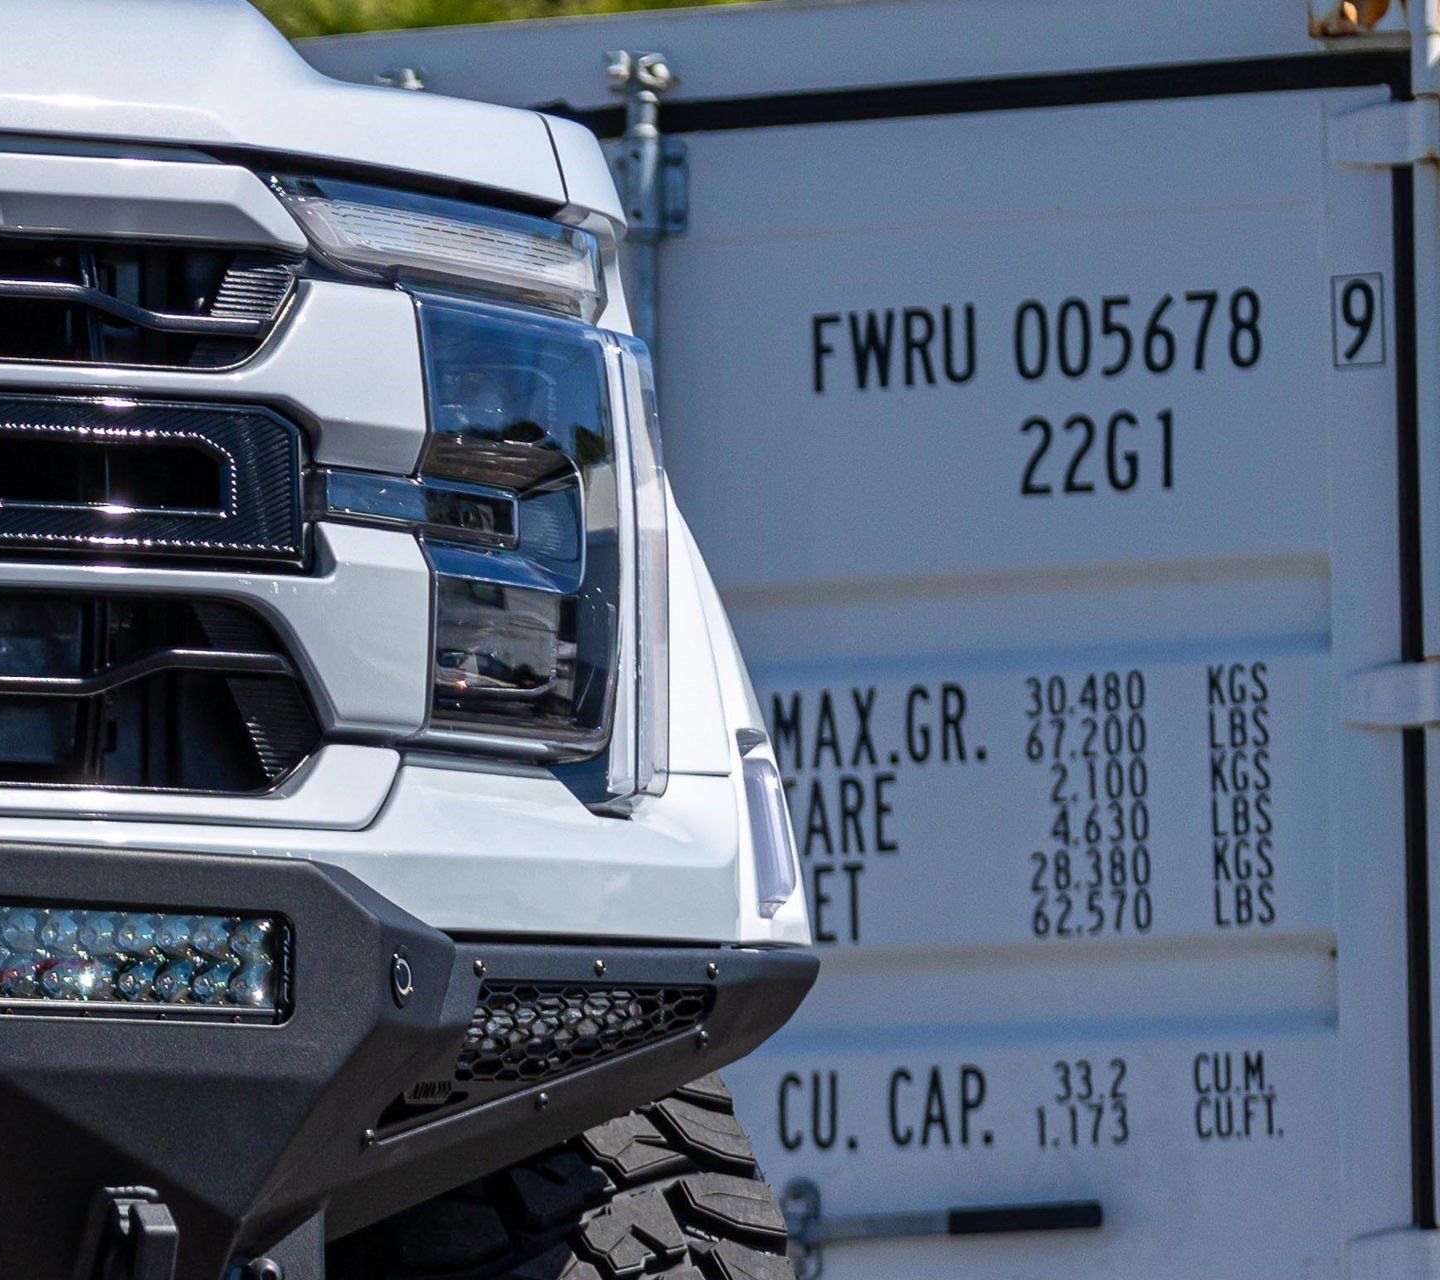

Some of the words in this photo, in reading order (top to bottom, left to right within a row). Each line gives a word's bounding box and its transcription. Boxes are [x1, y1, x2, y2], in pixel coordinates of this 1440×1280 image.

[812, 303, 977, 394] FWRU
[1013, 287, 1262, 382] 005678
[1341, 278, 1375, 361] 9
[1020, 408, 1174, 497] 22G1
[773, 682, 987, 770] MAX.GR.
[1025, 670, 1145, 718] 30.480
[1208, 662, 1268, 705] KGS
[1026, 712, 1146, 760] 67.200
[1210, 705, 1270, 749] LBS
[1051, 757, 1148, 803] 2.100
[1211, 749, 1271, 793] KGS
[1052, 800, 1149, 846] 4.630
[1213, 792, 1272, 837] LBS
[812, 862, 865, 943] ET
[1031, 843, 1151, 893] 28.380
[1214, 837, 1274, 881] KGS
[1033, 888, 1152, 936] 62.570
[1215, 881, 1275, 925] LBS
[779, 1068, 858, 1151] CU.
[889, 1063, 994, 1147] CAP.
[1054, 1058, 1127, 1102] 33.2
[1194, 1051, 1274, 1095] CU.M.
[1036, 1101, 1130, 1148] 1.173
[1195, 1093, 1284, 1141] CU.FT.
